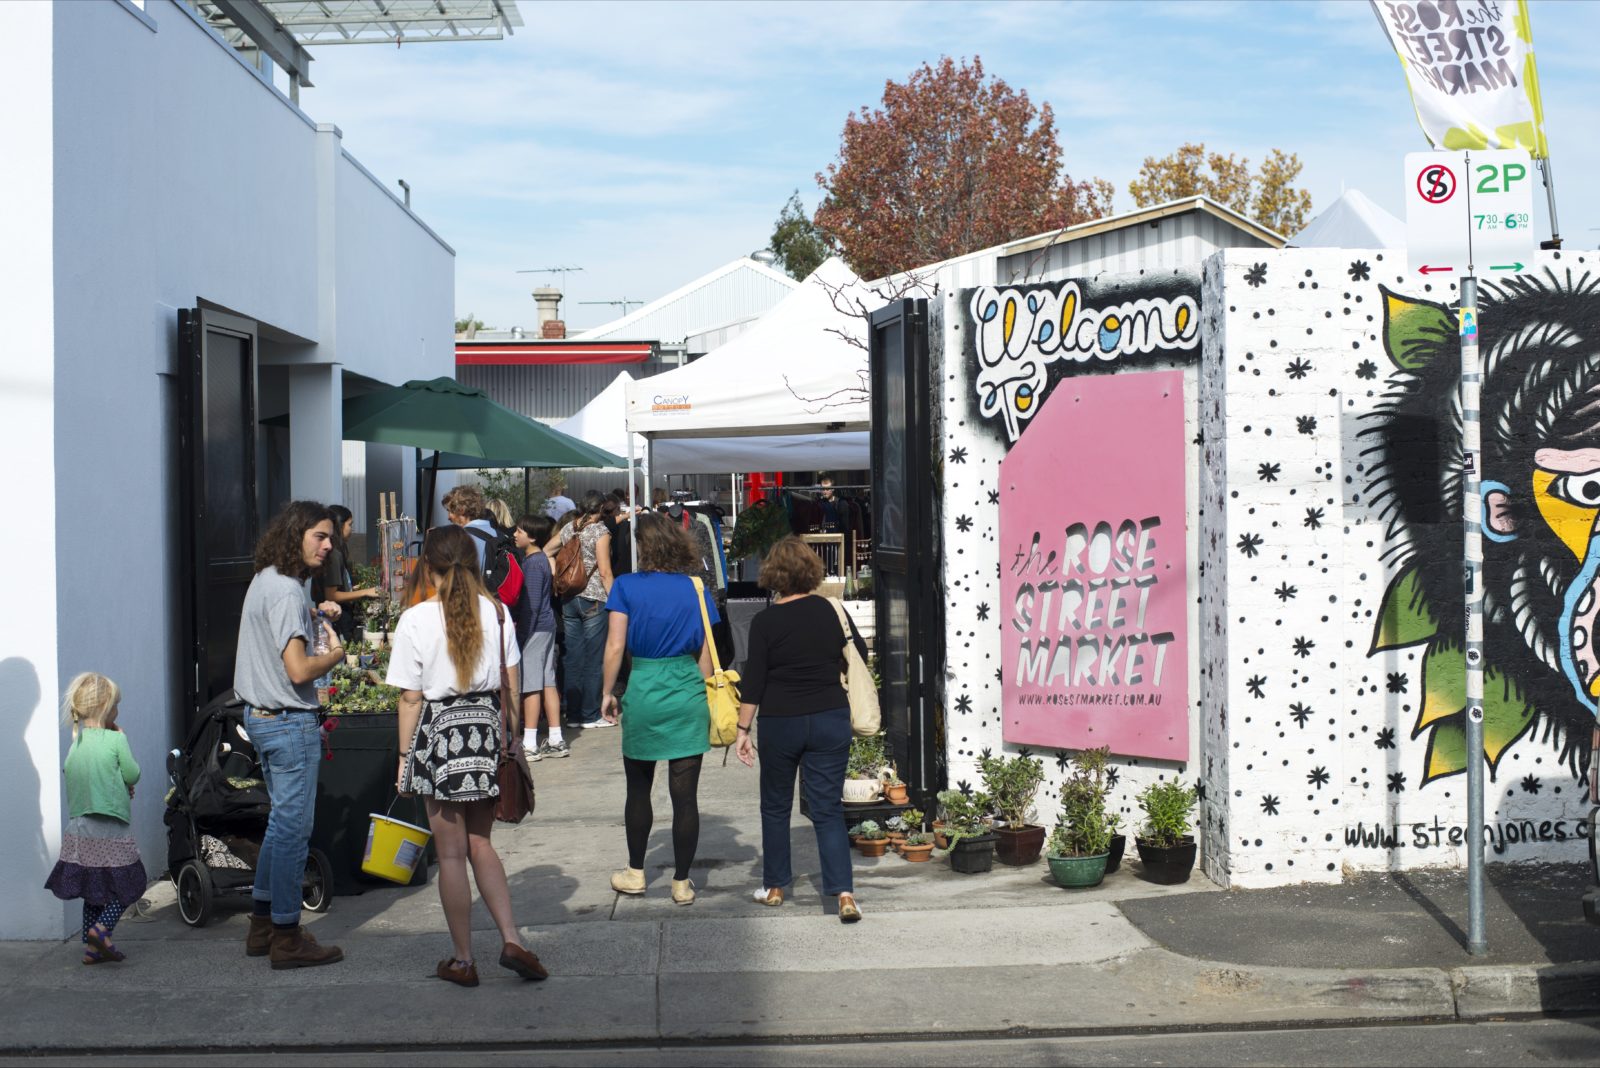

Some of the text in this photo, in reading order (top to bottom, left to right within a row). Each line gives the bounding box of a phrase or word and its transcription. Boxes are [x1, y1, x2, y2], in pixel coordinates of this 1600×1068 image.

[1476, 163, 1526, 194] 2P
[975, 284, 1200, 368] Welcome
[1011, 516, 1161, 576] the ROSE
[1012, 574, 1158, 633] STREET
[1016, 632, 1175, 688] MARKET
